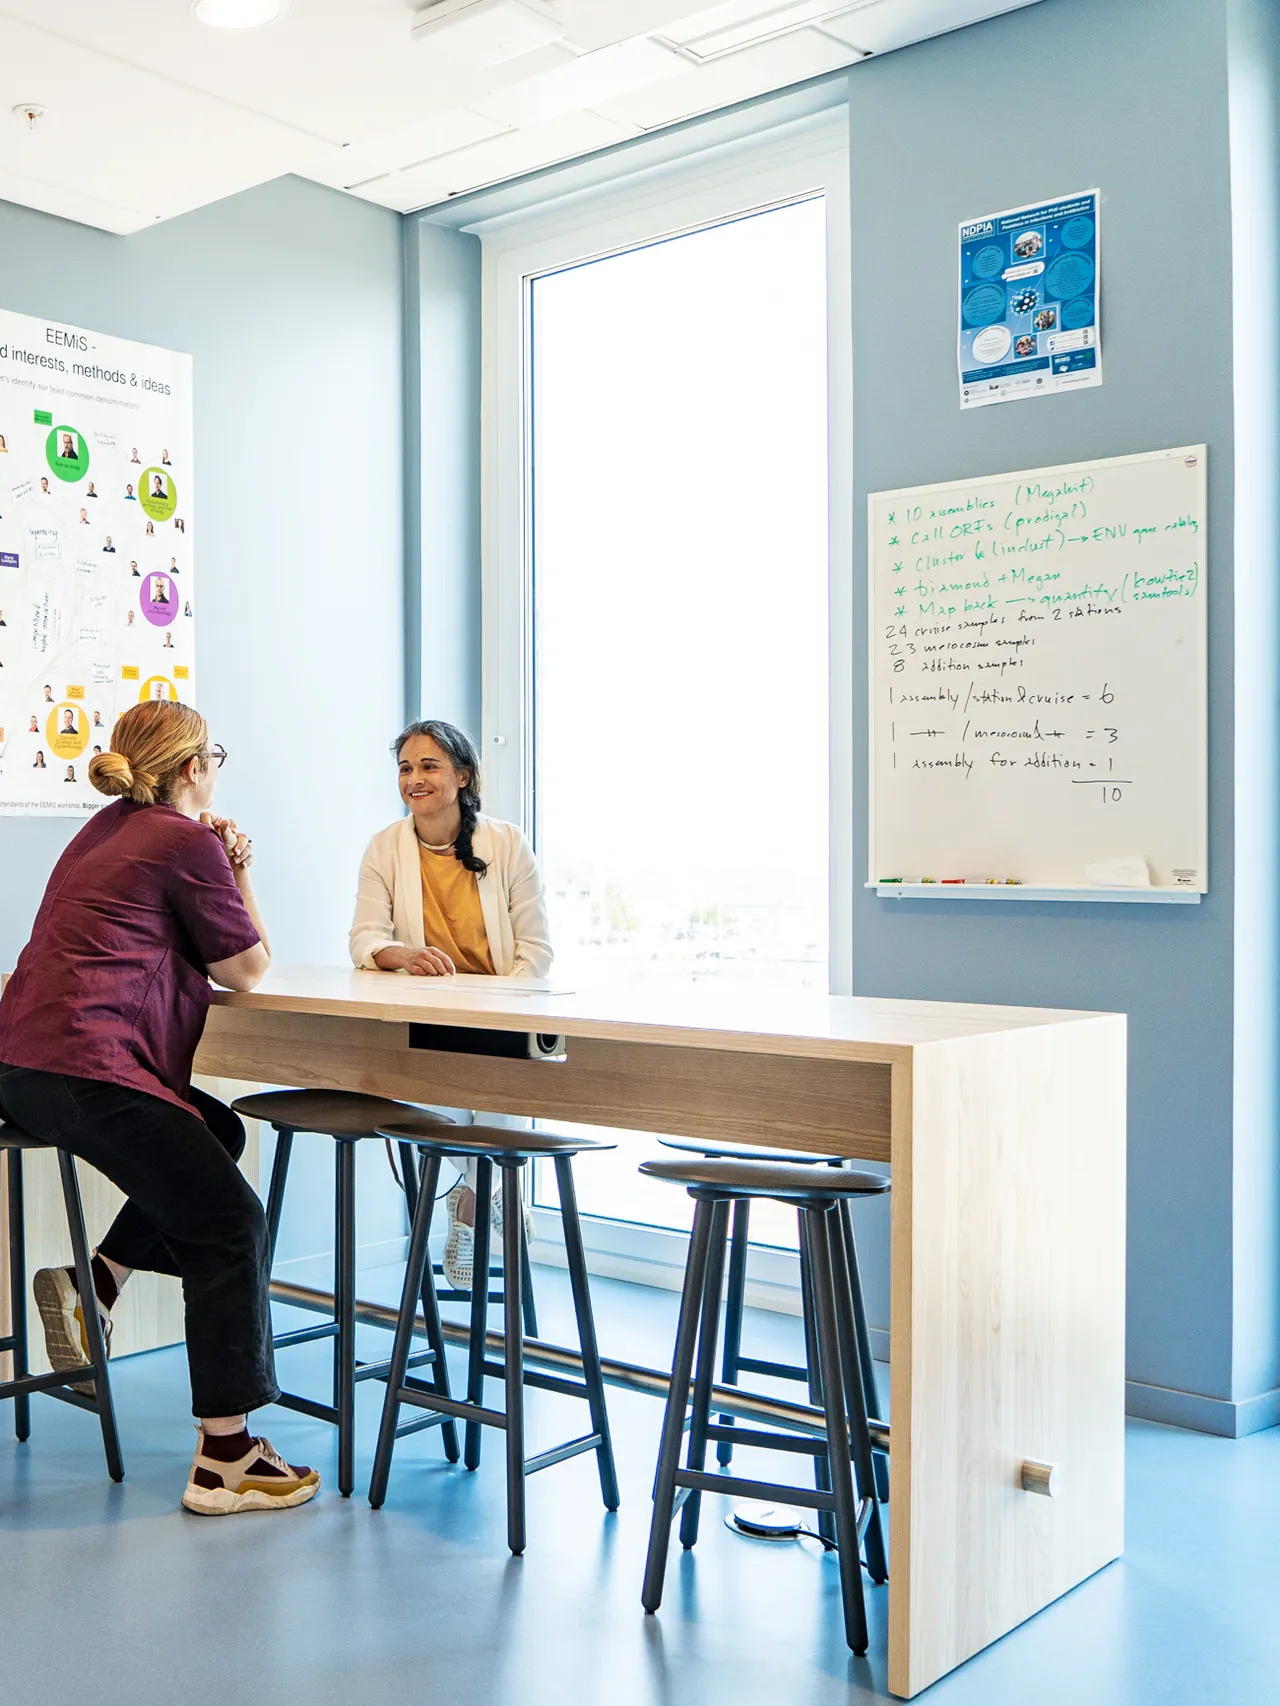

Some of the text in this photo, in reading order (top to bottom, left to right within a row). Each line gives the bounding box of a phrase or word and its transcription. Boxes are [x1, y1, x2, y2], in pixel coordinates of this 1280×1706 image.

[962, 221, 993, 237] NDPIA
[46, 328, 88, 352] EEMiS
[12, 346, 69, 374] interests,
[72, 361, 127, 385] methods
[130, 373, 138, 387] &
[141, 376, 171, 396] ideas
[11, 376, 36, 390] identify
[50, 385, 65, 395] least
[67, 390, 95, 401] common
[1093, 522, 1127, 542] ENV
[919, 601, 956, 619] Map
[885, 625, 907, 639] 24
[1018, 609, 1044, 622] from
[1052, 608, 1062, 621] 2
[894, 659, 905, 672] 8
[1104, 728, 1118, 743] 3
[989, 751, 1017, 768] for
[1103, 786, 1122, 803] 10
[82, 802, 100, 810] Bigger
